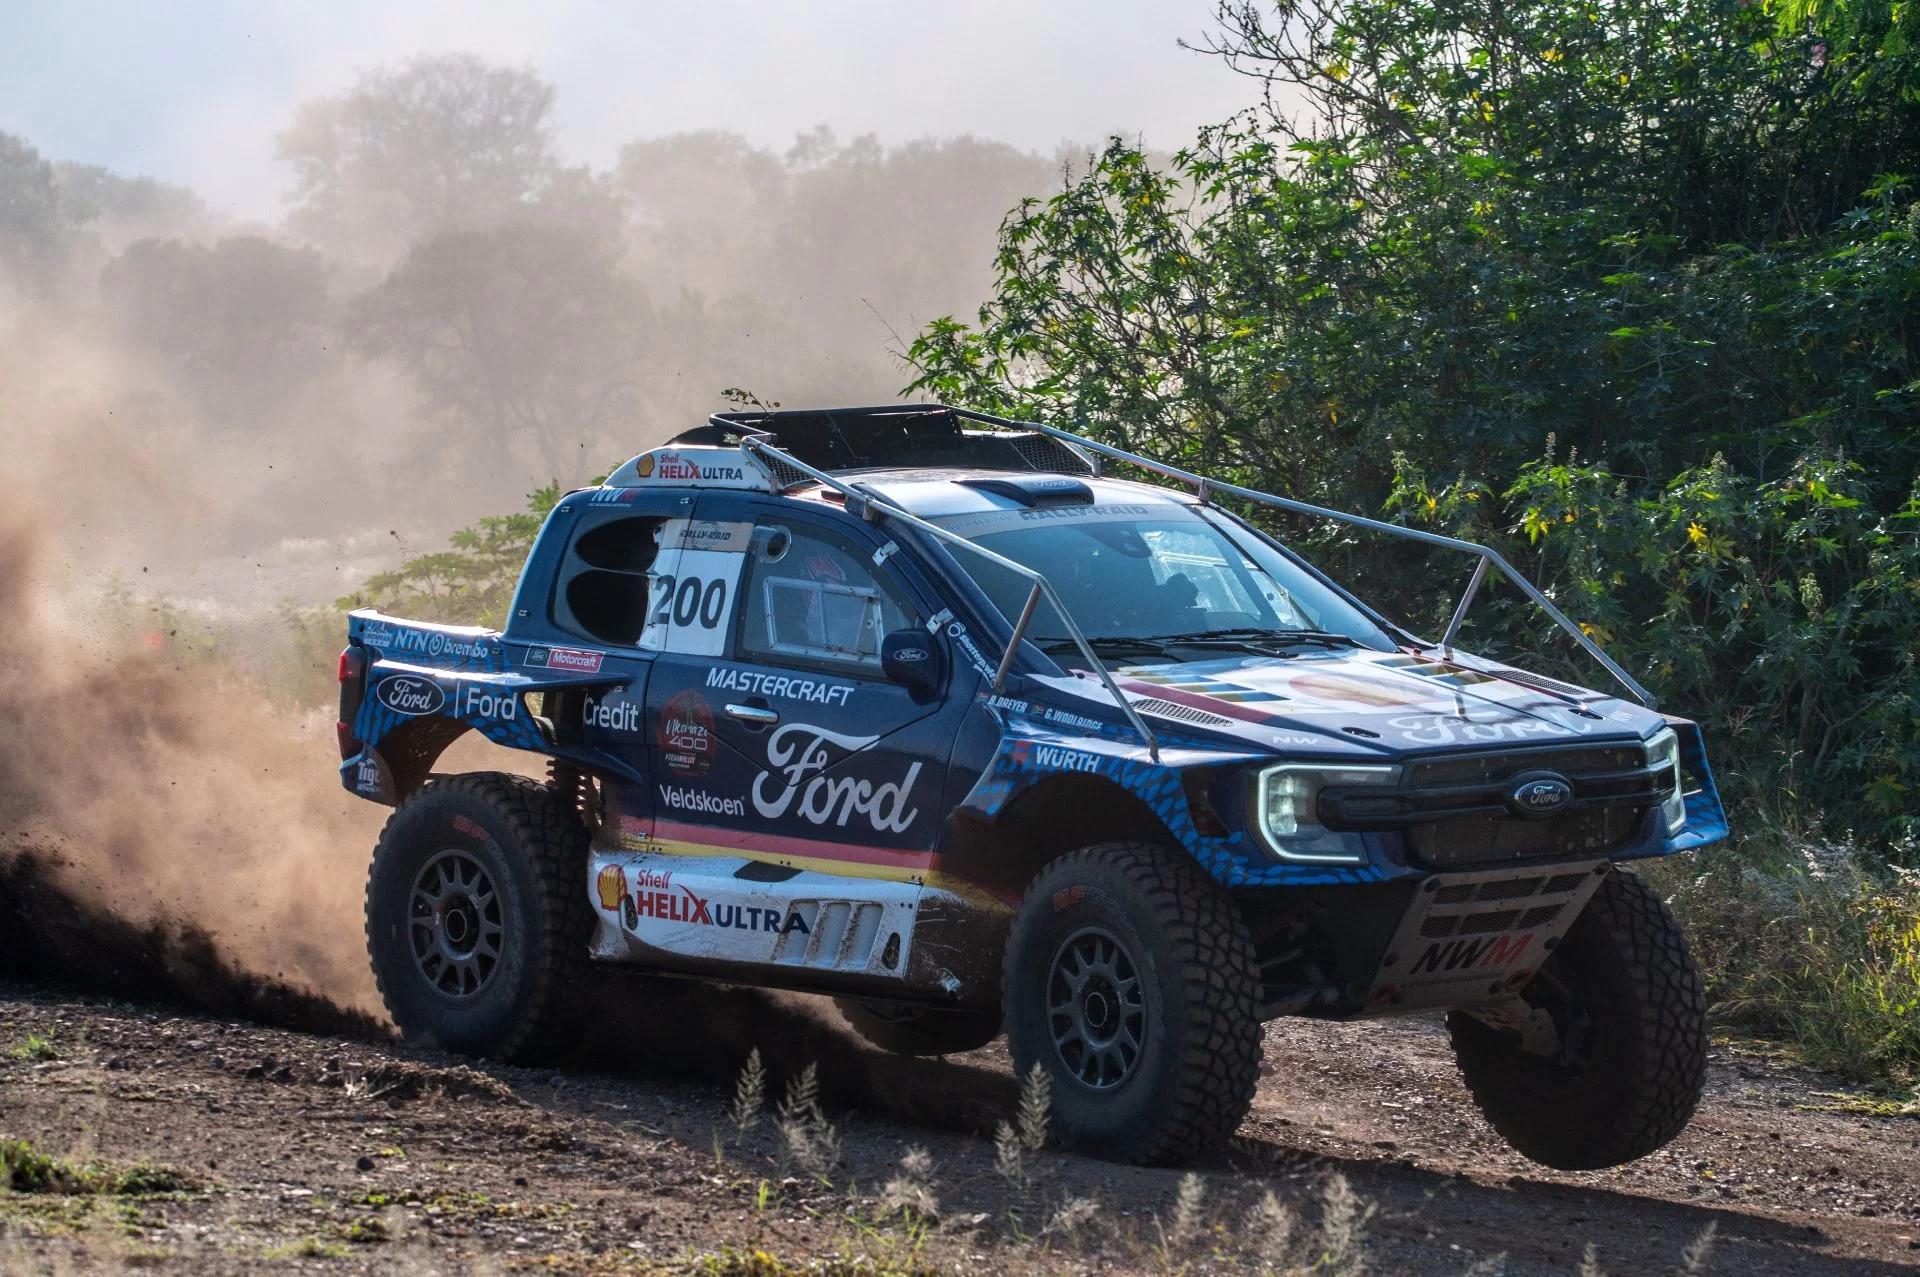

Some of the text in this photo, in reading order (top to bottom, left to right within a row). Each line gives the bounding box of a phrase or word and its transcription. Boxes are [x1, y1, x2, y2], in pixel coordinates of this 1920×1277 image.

[660, 453, 680, 464] Shell
[659, 462, 744, 480] HELIX ULTRA
[679, 529, 732, 541] RALLY-RAID
[650, 574, 727, 629] 200
[395, 629, 431, 651] NTN
[443, 639, 488, 658] brembo
[553, 652, 597, 668] Motorcraft
[899, 649, 922, 660] Ford
[389, 679, 433, 710] Ford
[706, 667, 855, 706] MASTERCRAFT
[466, 687, 639, 732] Ford Credit
[987, 695, 1028, 713] B.DREYER
[1387, 709, 1592, 746] Ford
[669, 735, 708, 751] 400
[752, 722, 923, 834] Ford
[659, 784, 744, 816] Veldskoen
[1529, 785, 1561, 805] Ford
[637, 869, 673, 889] Shell
[637, 887, 811, 935] HELIX ULTRA
[1409, 932, 1535, 975] NWM
